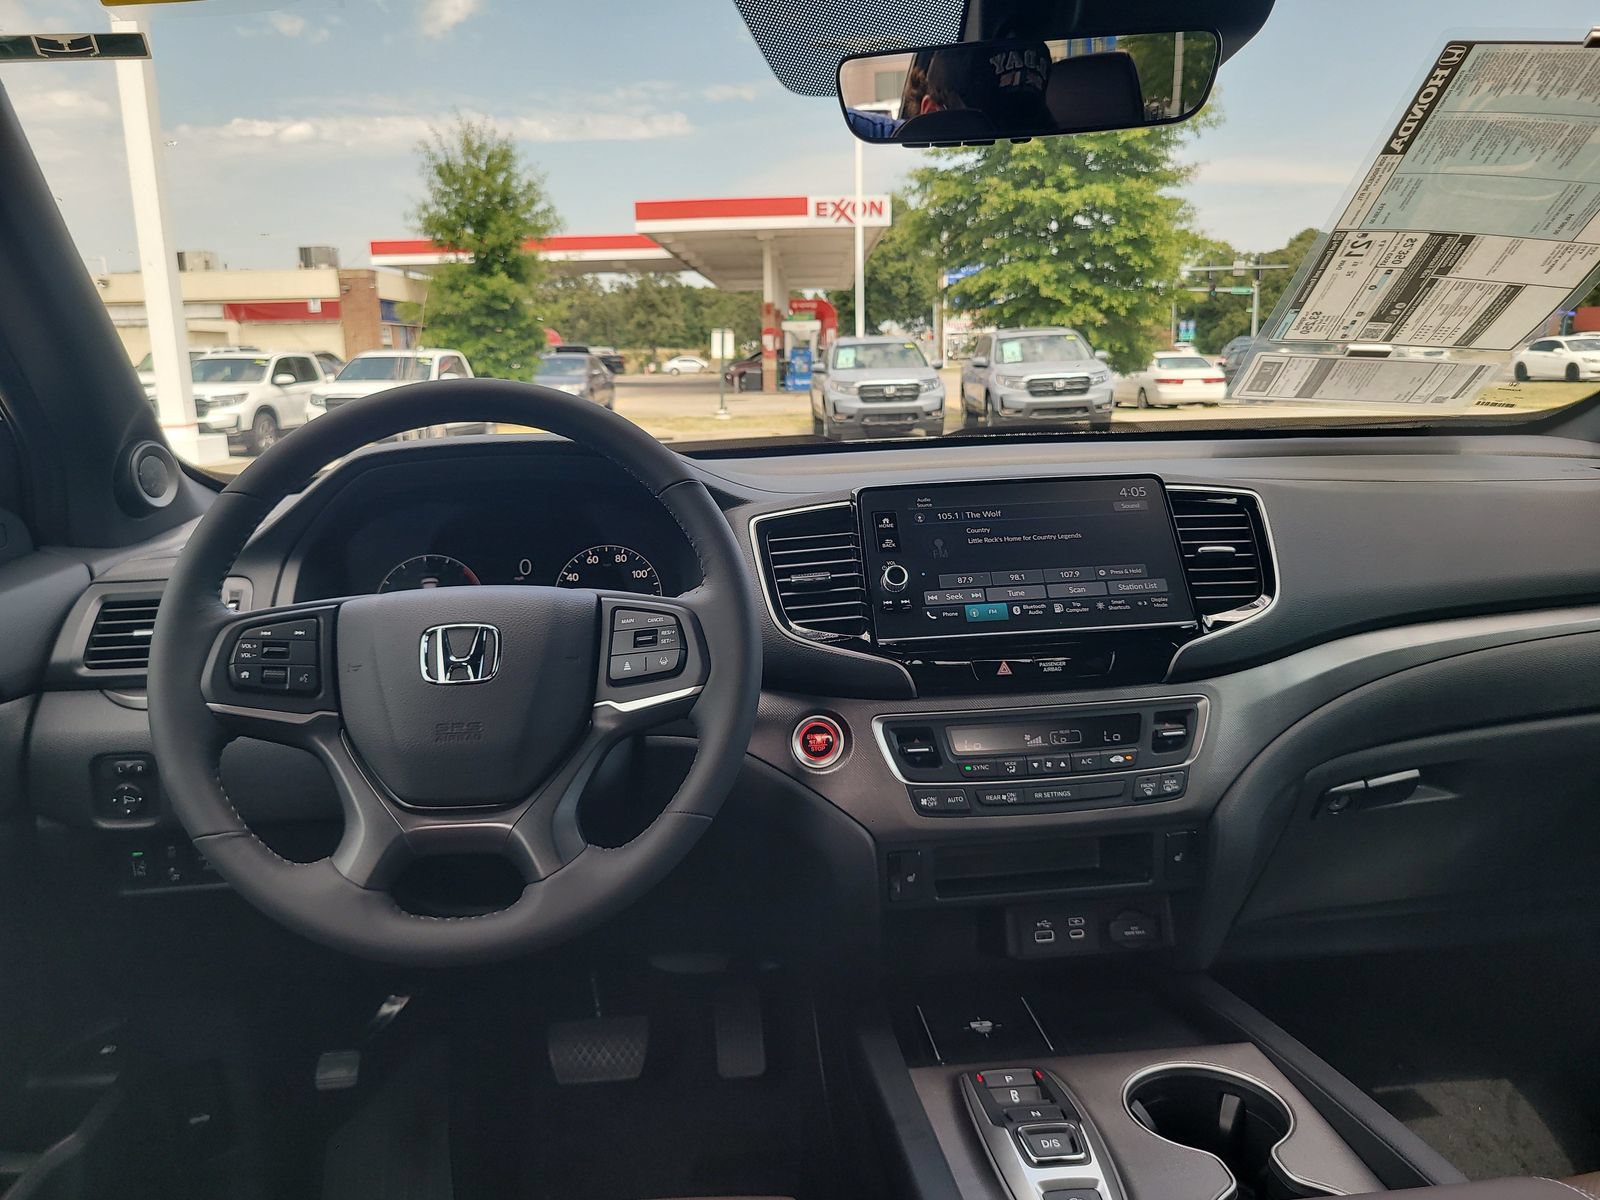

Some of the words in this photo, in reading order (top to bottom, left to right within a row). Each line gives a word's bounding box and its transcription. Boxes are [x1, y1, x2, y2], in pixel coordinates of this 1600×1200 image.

[816, 200, 882, 224] EXXON
[1120, 486, 1146, 497] 4:05
[586, 556, 598, 564] 60
[615, 554, 627, 562] 80
[520, 558, 532, 575] 0
[566, 573, 579, 582] 40
[632, 570, 648, 578] 100
[1041, 1139, 1061, 1148] D/S
